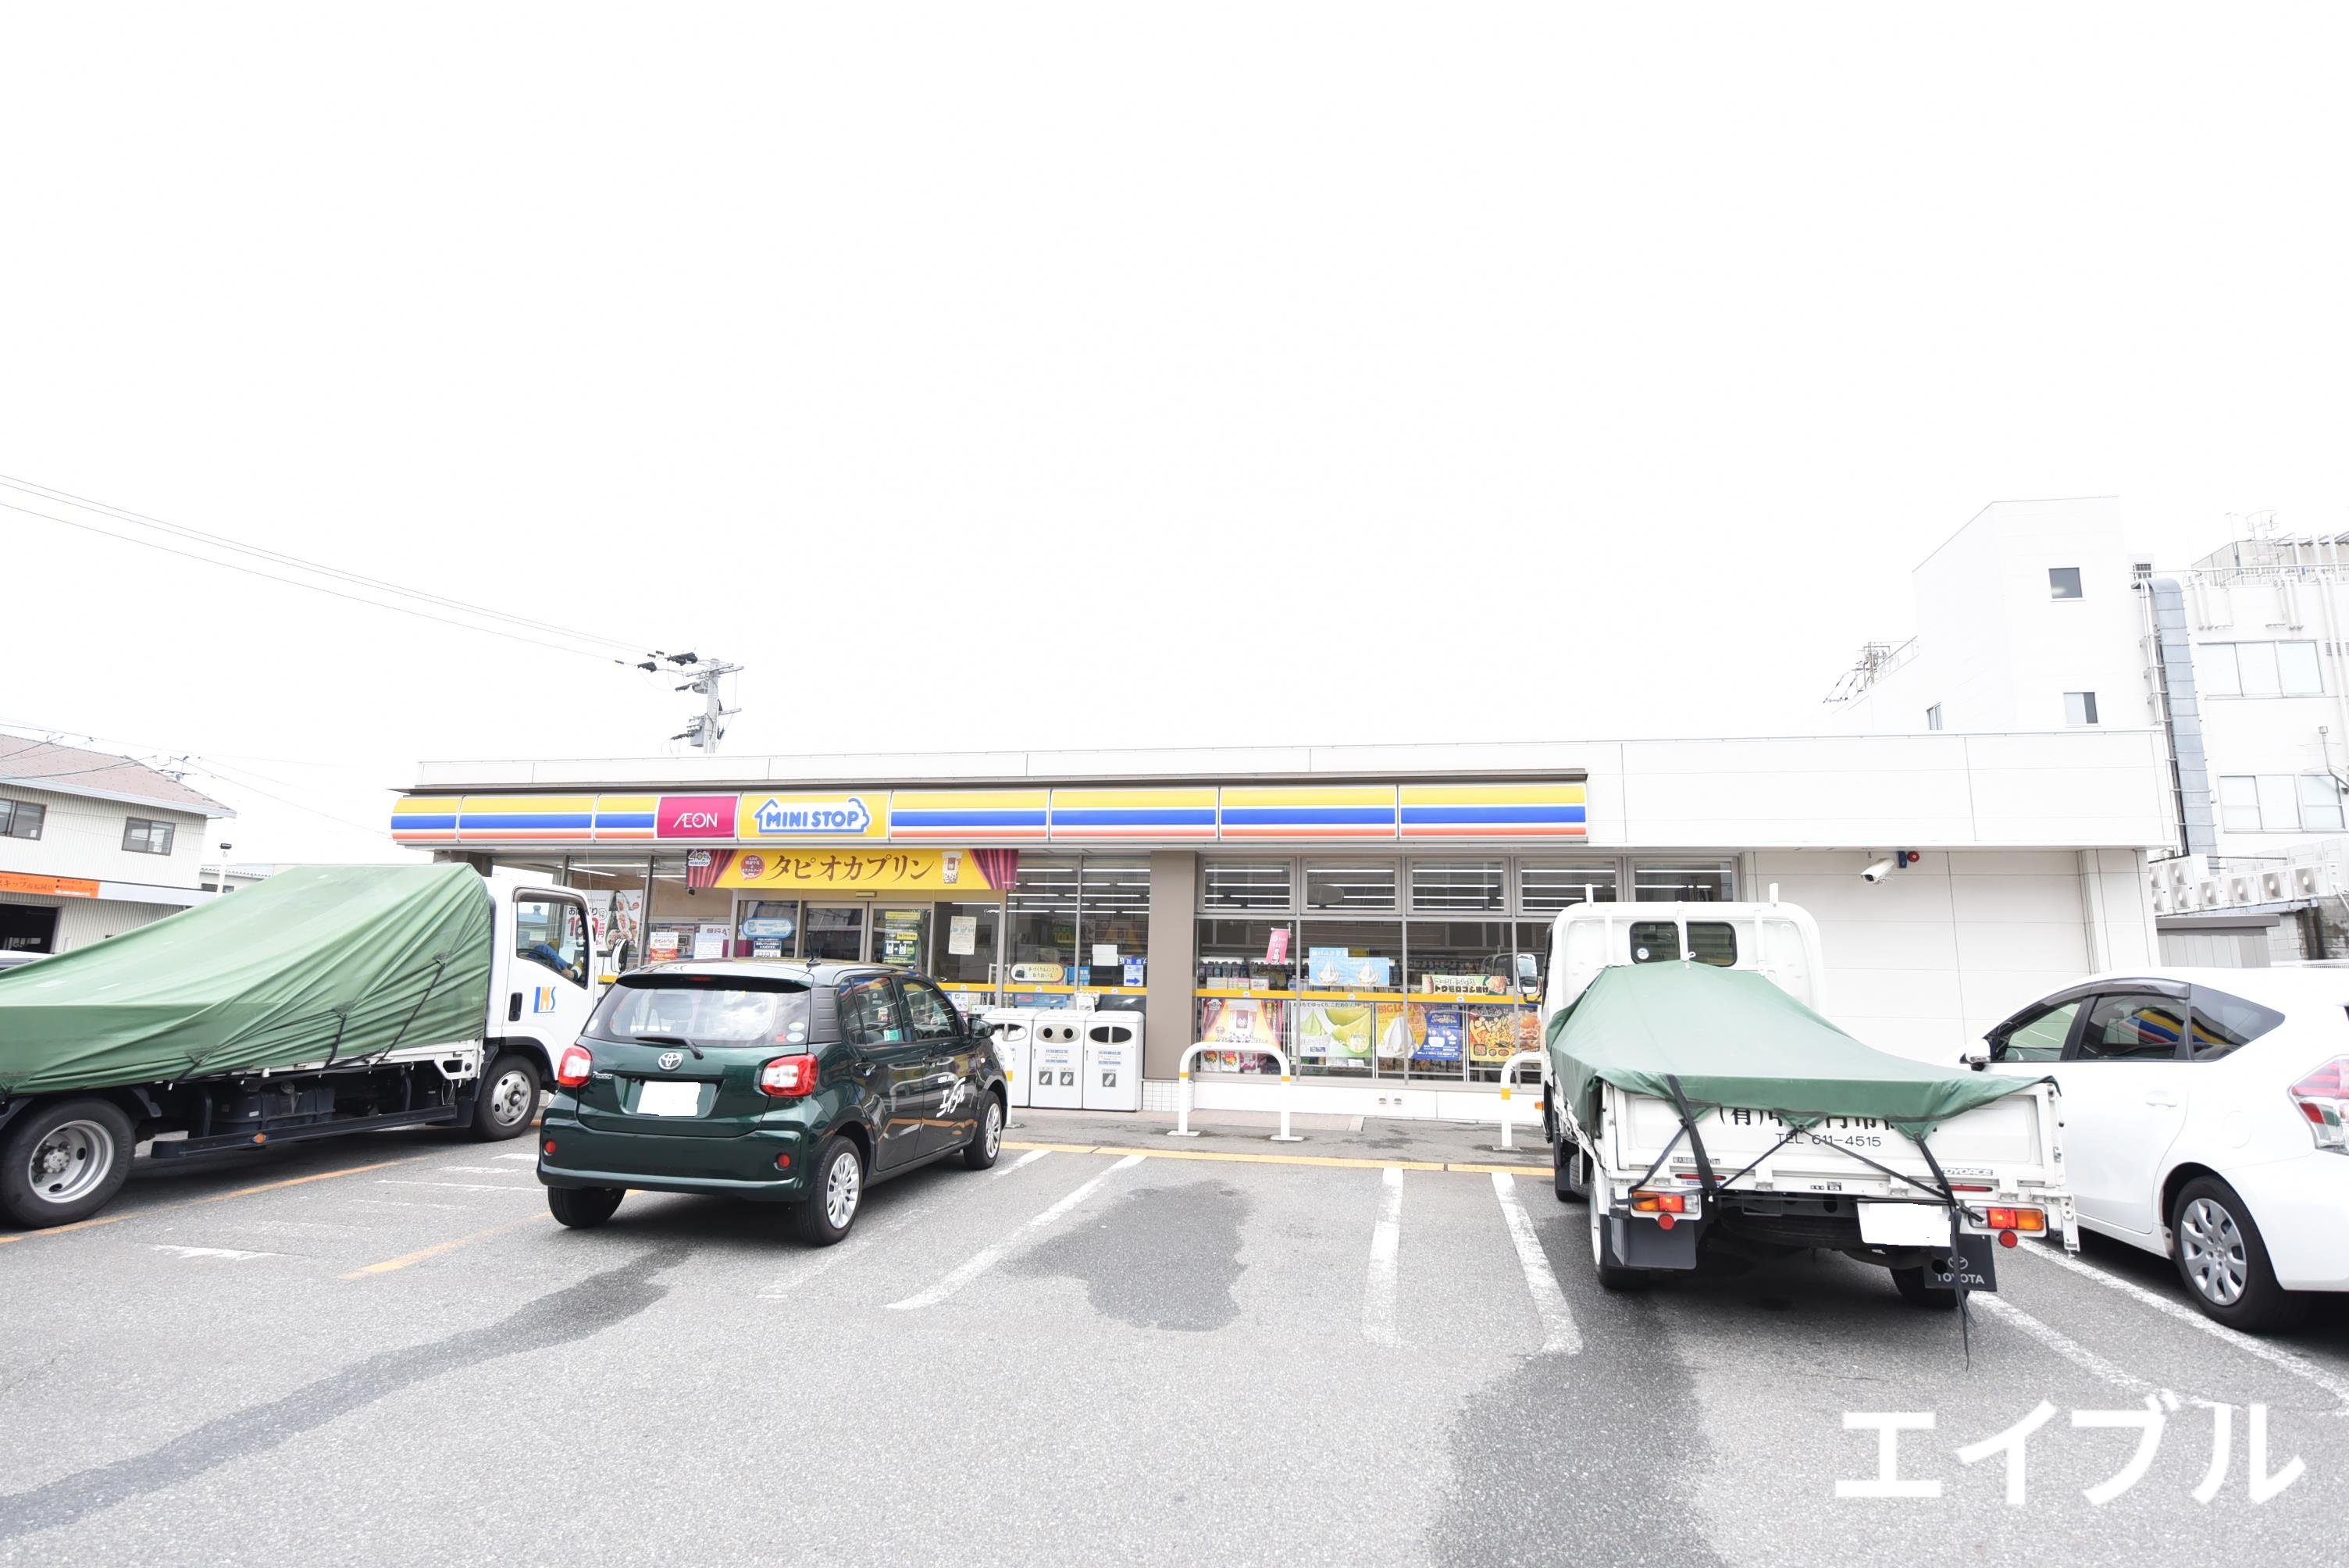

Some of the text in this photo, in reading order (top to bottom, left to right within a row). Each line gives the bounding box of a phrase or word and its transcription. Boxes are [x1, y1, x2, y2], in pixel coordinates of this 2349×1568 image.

[765, 811, 860, 827] MINI STOP
[765, 854, 935, 882] タピオカプリン
[1775, 1132, 1882, 1147] TEL 611-4515
[1937, 1272, 1985, 1285] TOOTA
